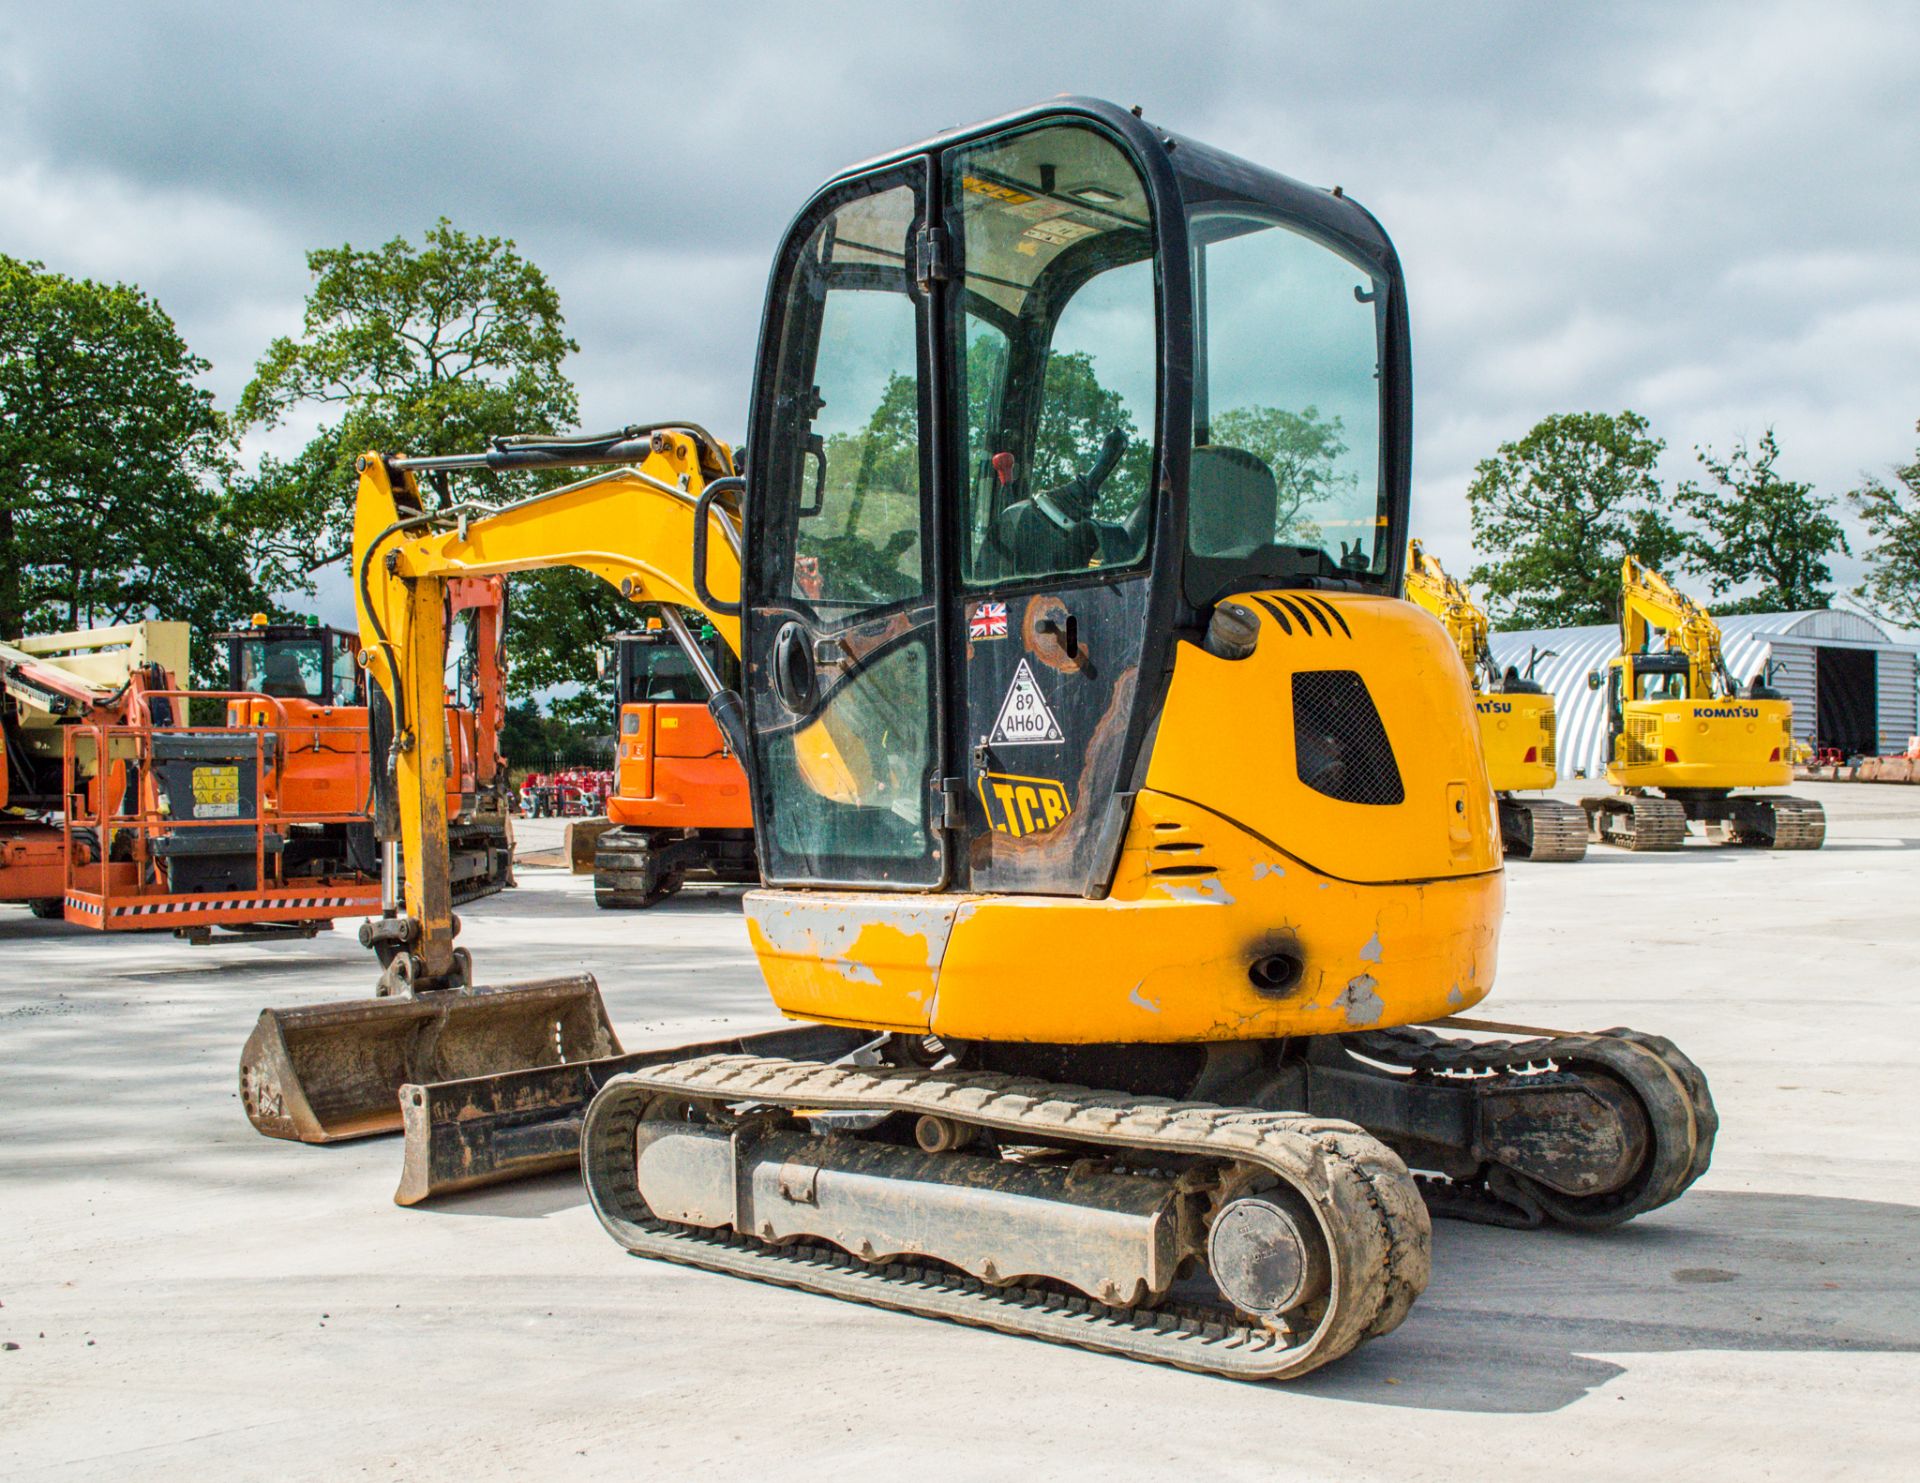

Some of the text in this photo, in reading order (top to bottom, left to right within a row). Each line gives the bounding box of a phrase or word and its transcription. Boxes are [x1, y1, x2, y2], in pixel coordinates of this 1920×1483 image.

[1016, 693, 1034, 711] 89
[1693, 706, 1759, 718] KOMATSU
[1006, 714, 1044, 732] AH60
